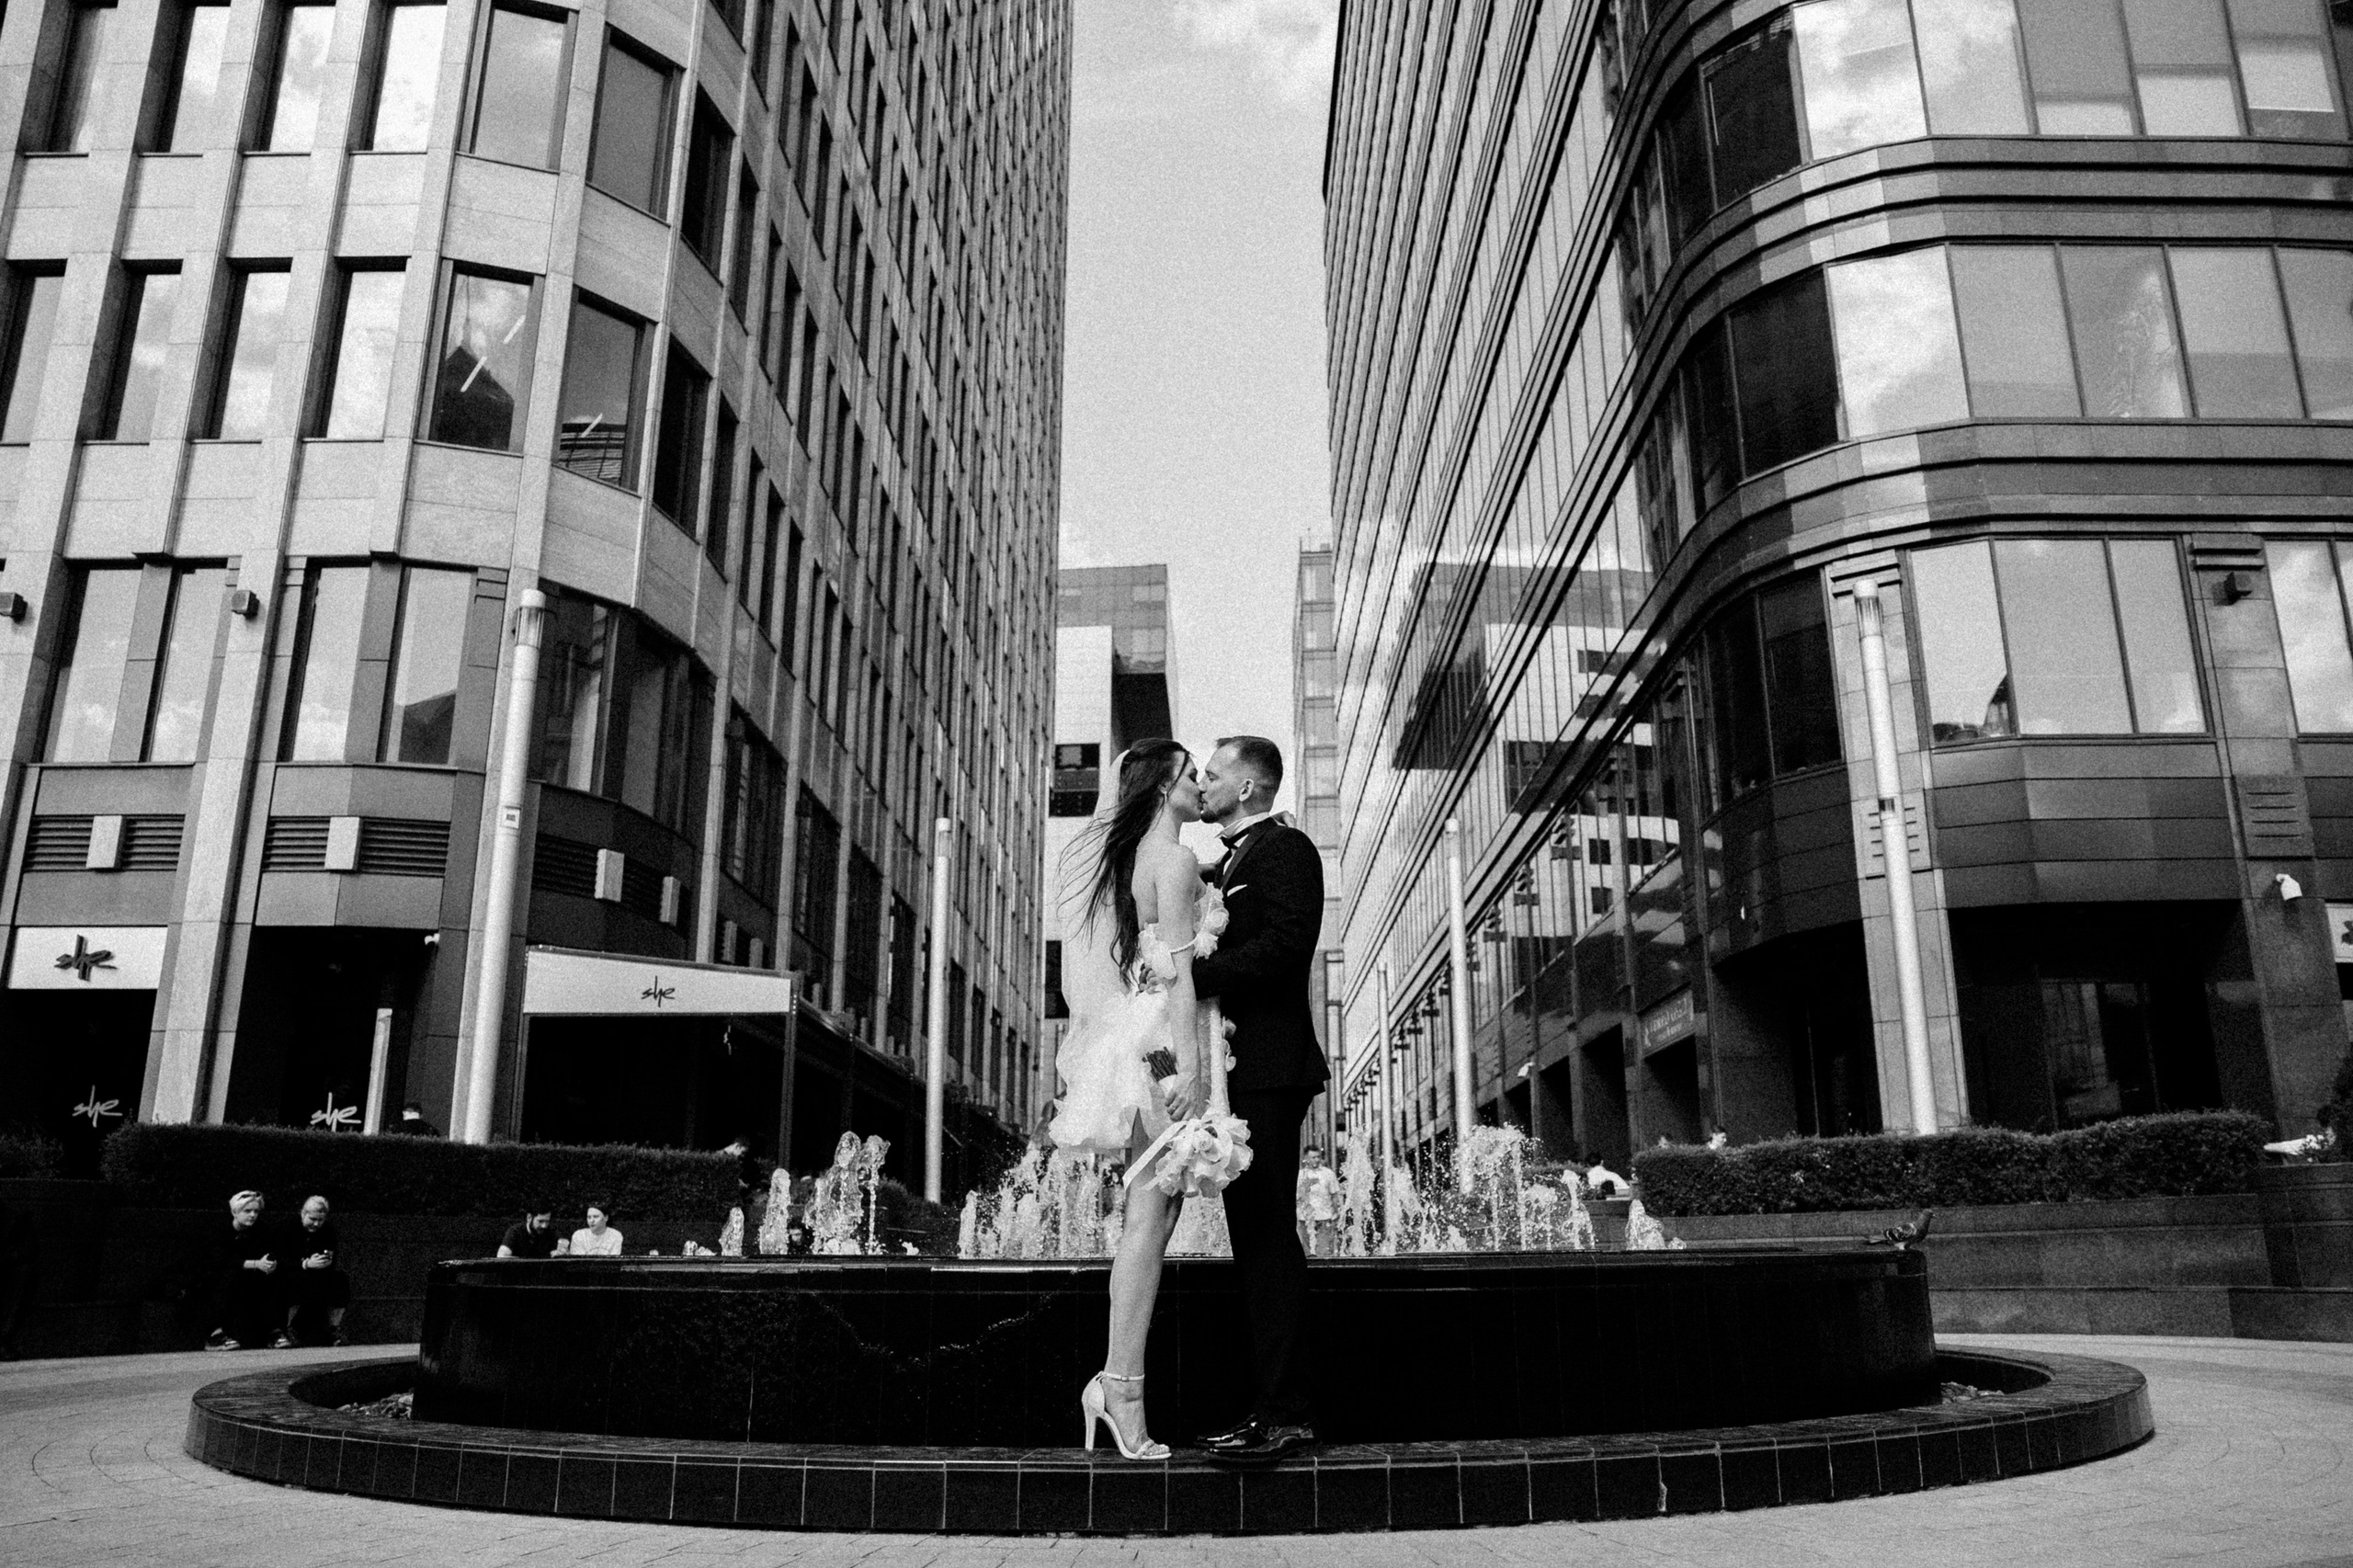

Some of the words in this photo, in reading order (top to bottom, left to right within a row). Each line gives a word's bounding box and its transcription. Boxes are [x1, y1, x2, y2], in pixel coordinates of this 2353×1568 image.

[641, 975, 676, 1007] she
[72, 1085, 122, 1128] she
[311, 1092, 361, 1132] she
